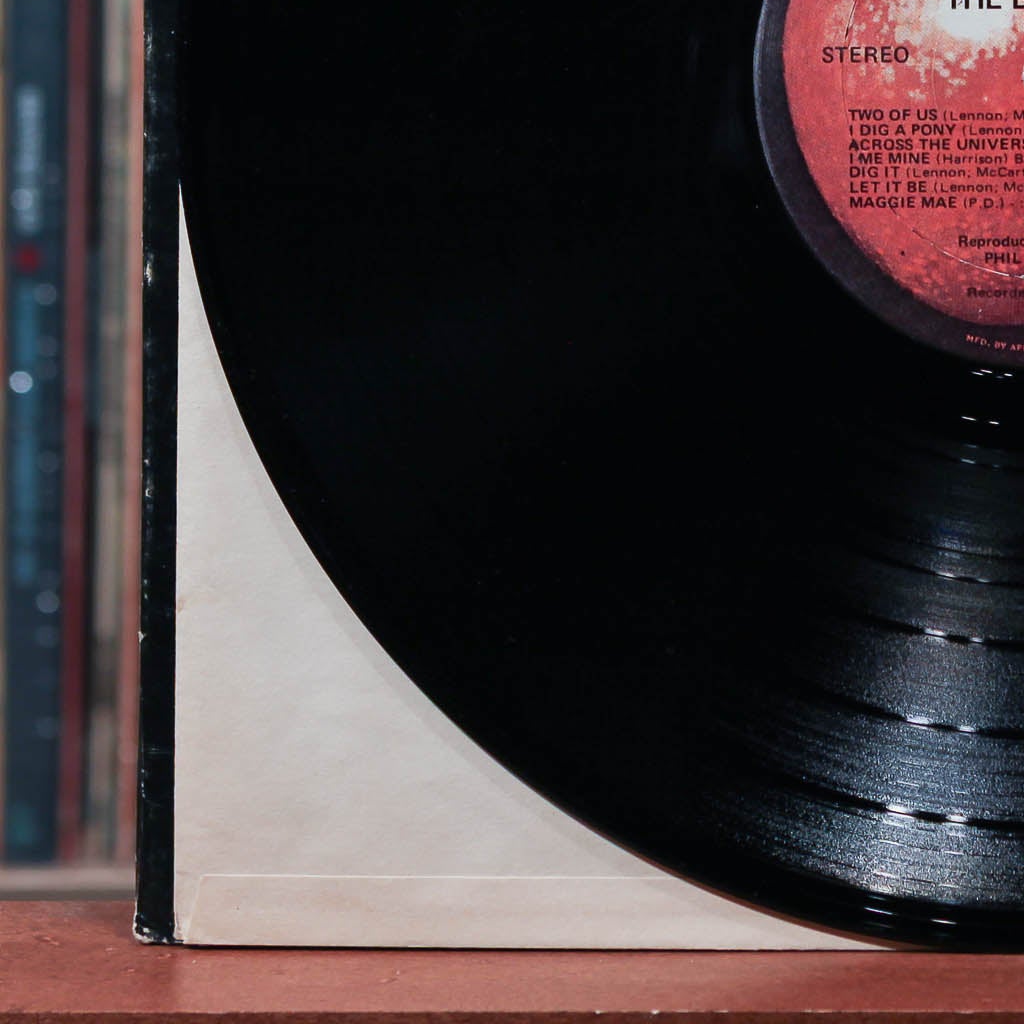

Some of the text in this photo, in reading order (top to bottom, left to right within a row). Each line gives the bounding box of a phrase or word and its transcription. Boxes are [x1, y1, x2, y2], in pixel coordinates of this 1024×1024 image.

[822, 46, 909, 63] STEREO
[848, 109, 884, 121] TWO
[889, 109, 911, 121] OF
[917, 109, 938, 121] US
[860, 124, 889, 136] DIG
[895, 124, 906, 136] A
[912, 124, 956, 136] PONY
[849, 139, 913, 151] ACROSS
[919, 139, 950, 151] THE
[859, 153, 882, 164] ME
[889, 153, 930, 164] MINE
[936, 153, 1008, 164] (Harrison)
[850, 166, 878, 178] DIG
[885, 166, 900, 177] IT
[850, 181, 880, 193] LET
[886, 181, 902, 193] IT
[907, 181, 927, 193] BE
[850, 196, 915, 208] MAGGIE
[922, 196, 957, 208] MAE
[963, 197, 1004, 209] (P.D.)
[985, 252, 1021, 264] PHIL
[994, 341, 1006, 350] BY
